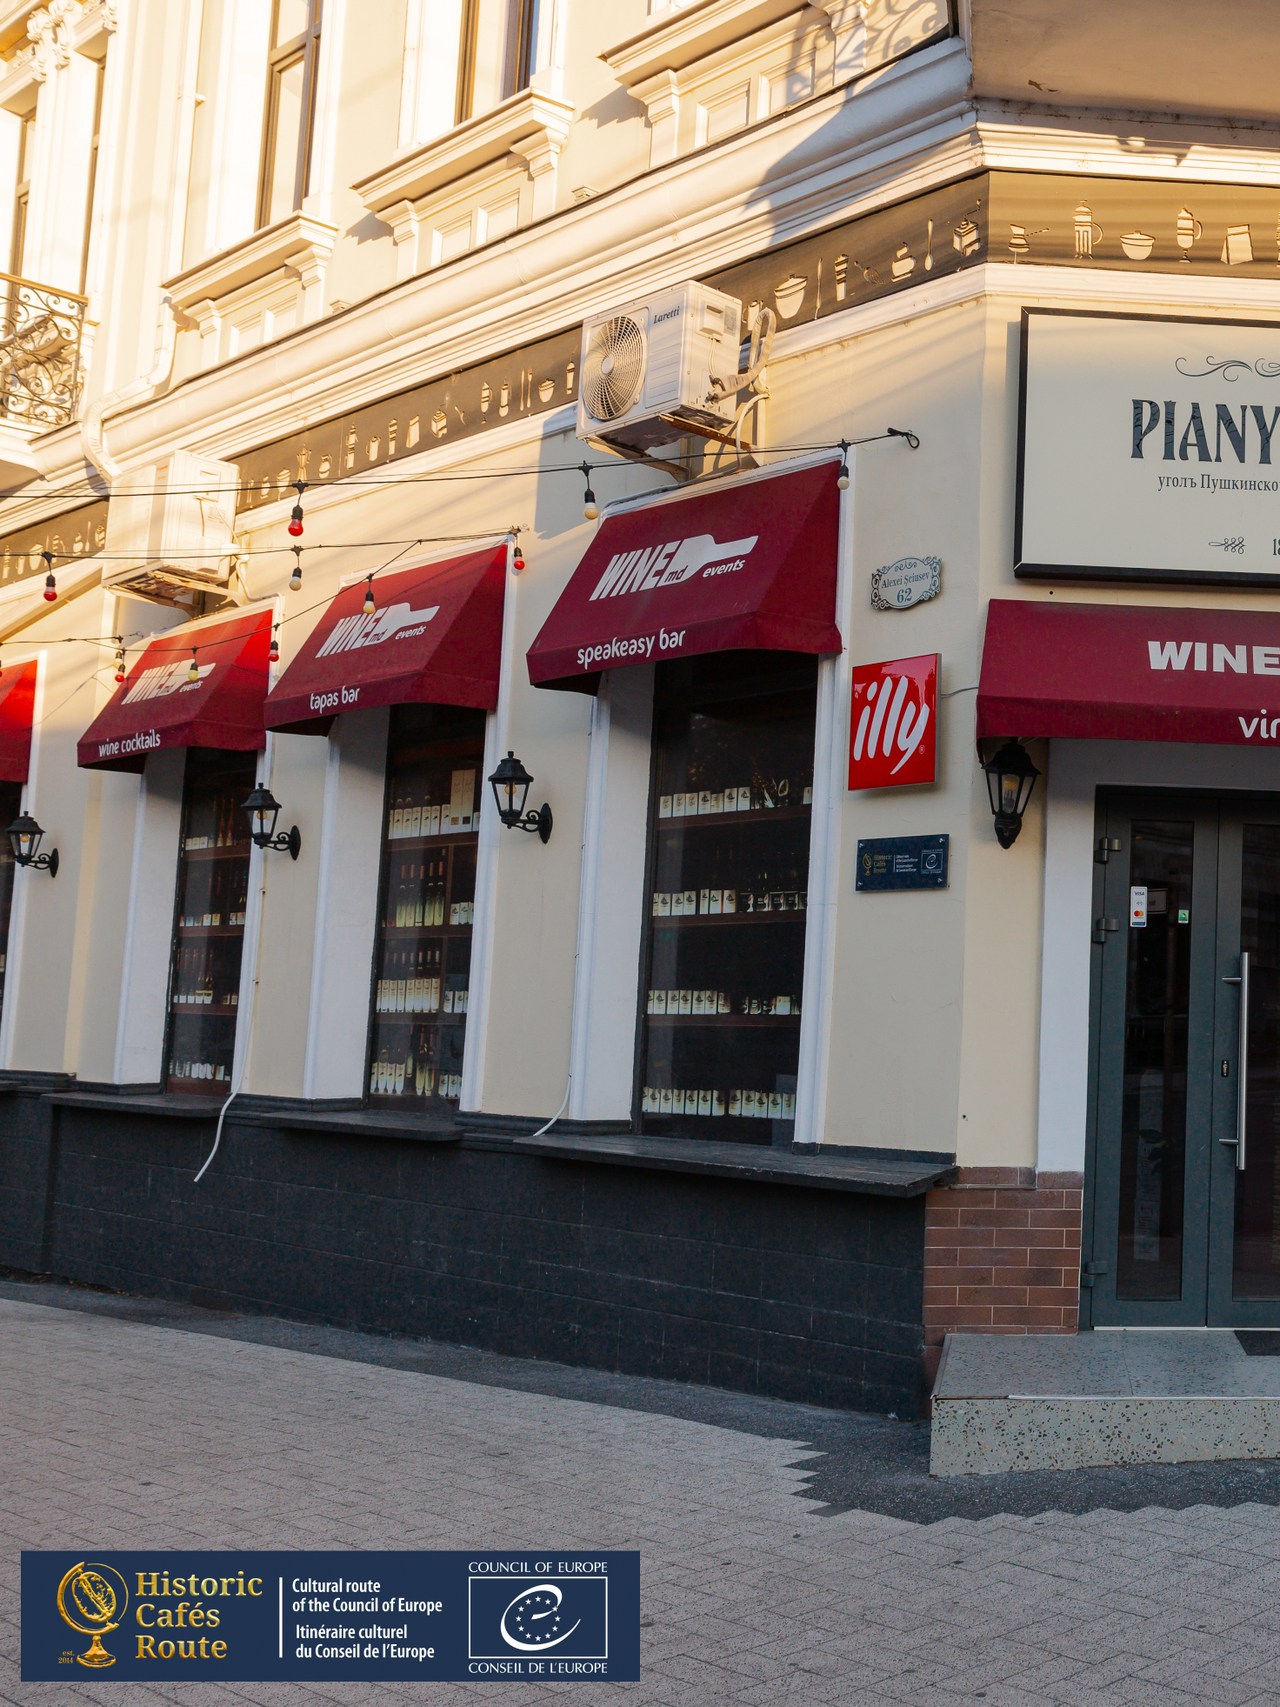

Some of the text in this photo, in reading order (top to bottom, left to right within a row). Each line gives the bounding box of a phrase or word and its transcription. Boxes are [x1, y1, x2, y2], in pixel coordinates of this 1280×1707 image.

[653, 305, 680, 324] Laretti
[1157, 475, 1197, 491] уголъ
[589, 540, 745, 601] WINE md events
[881, 574, 903, 589] Alexei
[896, 588, 912, 603] 62
[314, 606, 389, 658] WINE
[395, 625, 427, 640] events
[577, 628, 686, 670] speakeasy bar
[310, 685, 360, 714] tapas bar
[853, 676, 930, 775] illy
[98, 729, 161, 758] wine cocktails
